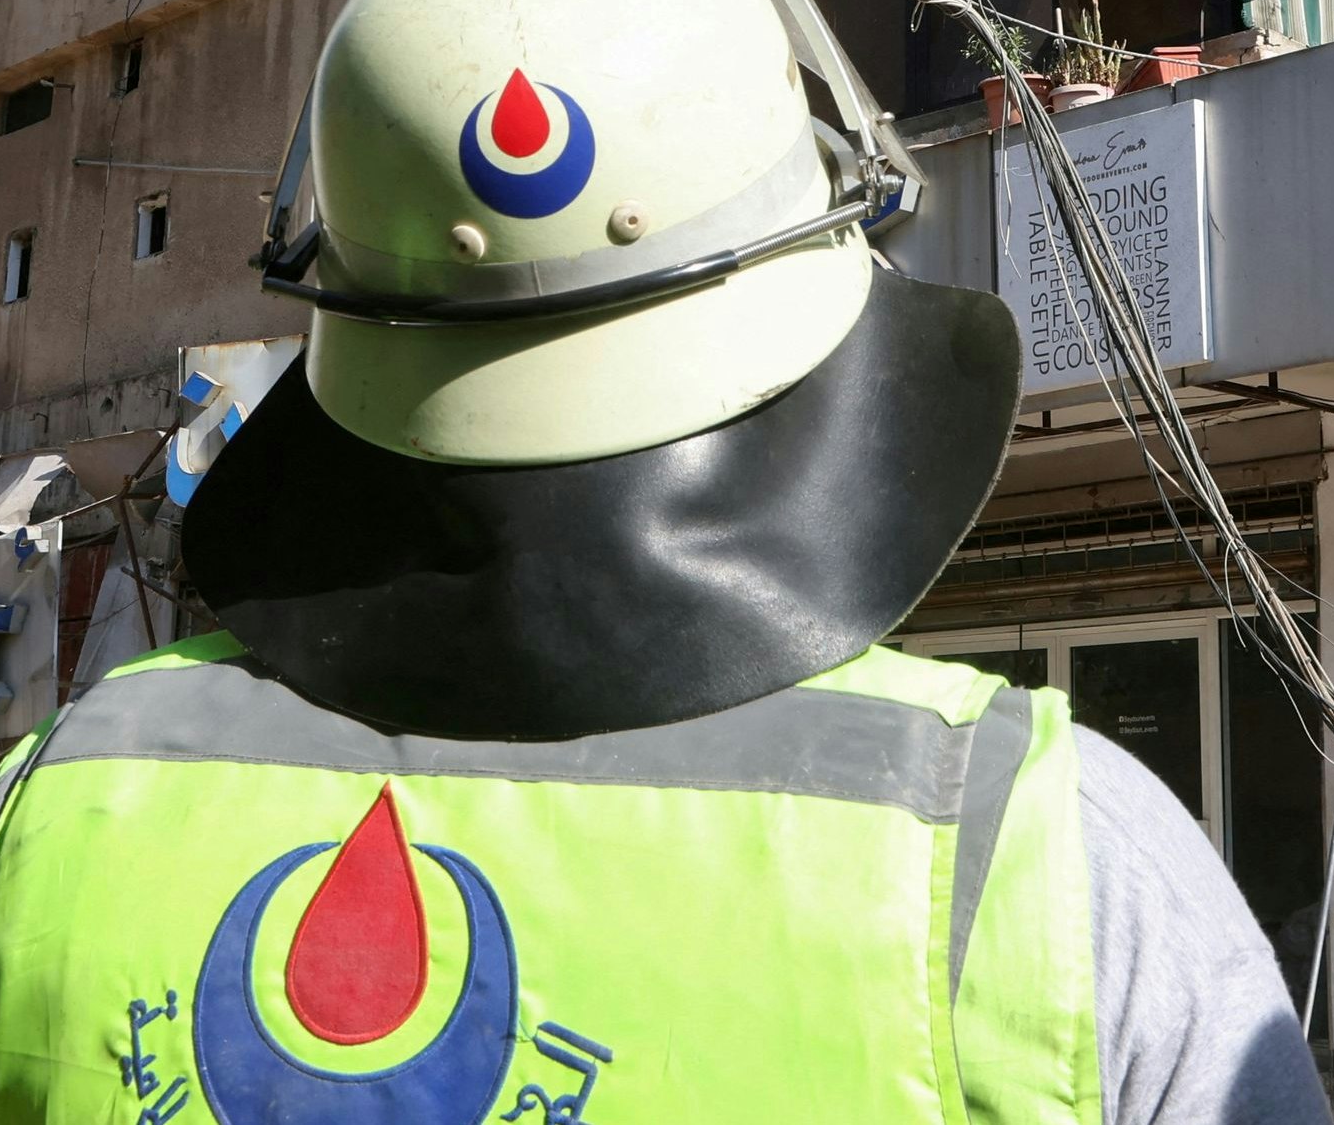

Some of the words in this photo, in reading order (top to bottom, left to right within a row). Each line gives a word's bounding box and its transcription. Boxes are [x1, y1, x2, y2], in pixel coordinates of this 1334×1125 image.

[1029, 211, 1048, 284] TABLE
[1100, 205, 1168, 236] OUND
[1154, 229, 1172, 352] PLANNER
[1030, 292, 1050, 375] SETUP
